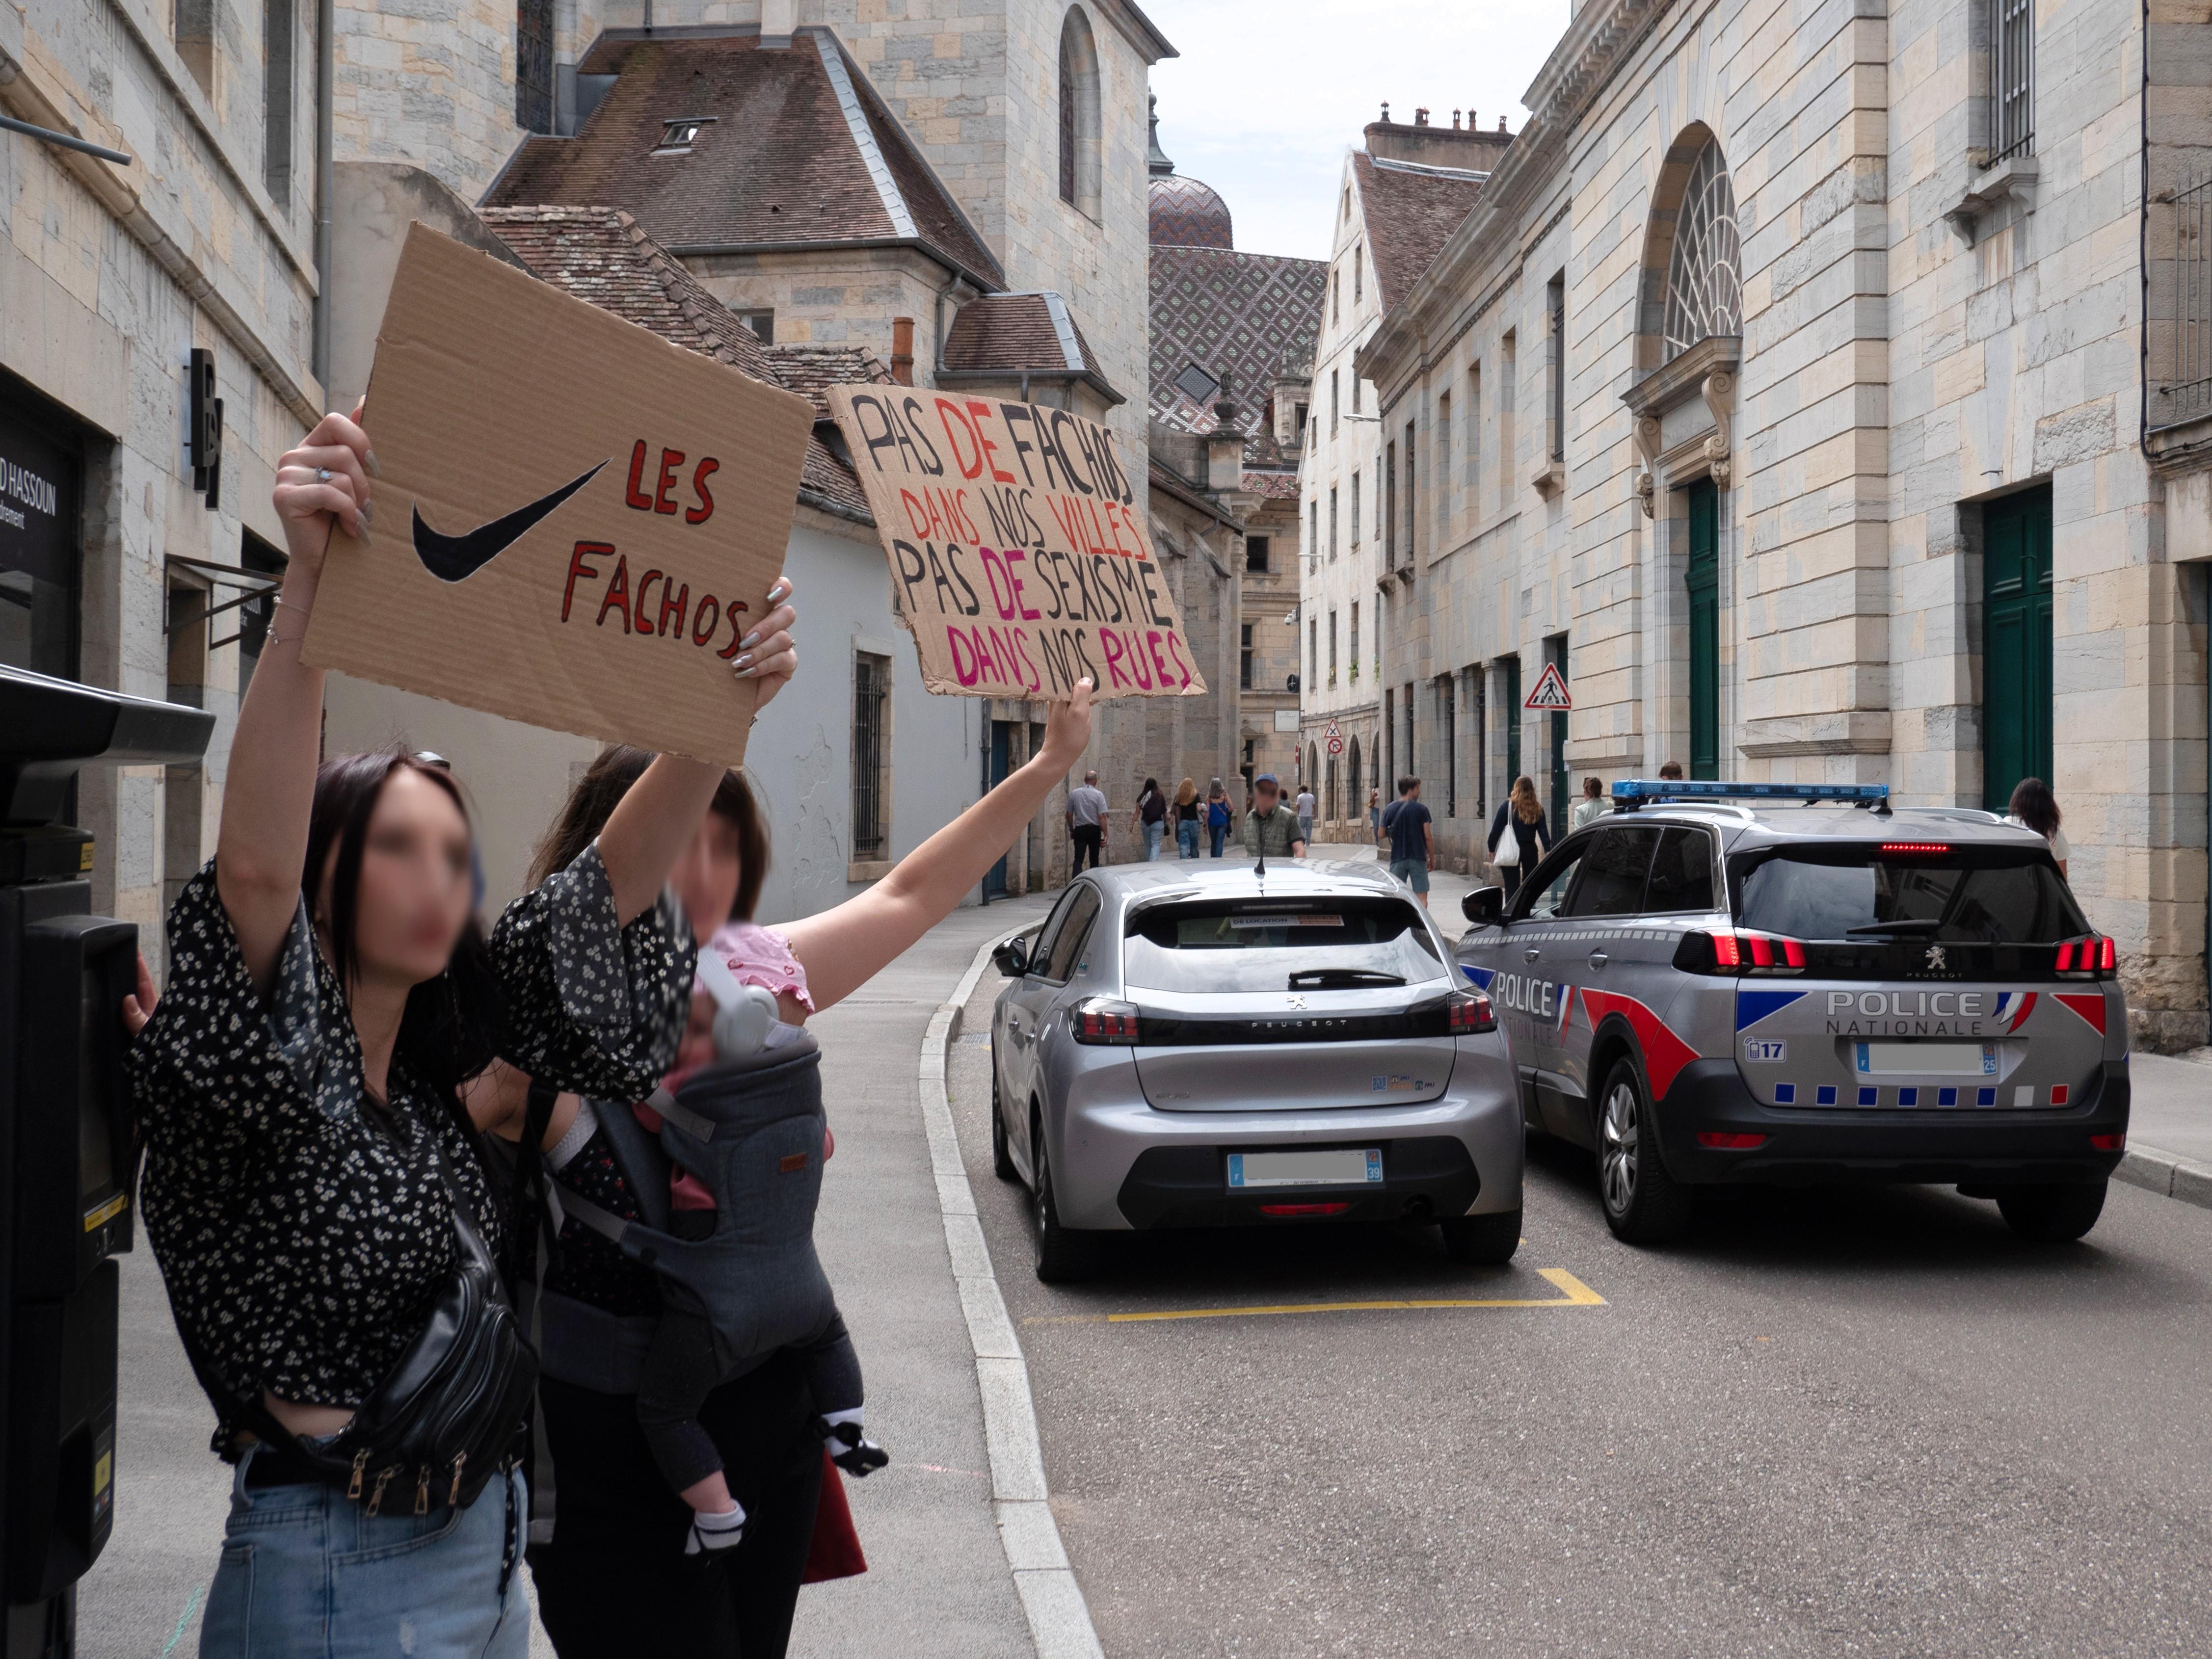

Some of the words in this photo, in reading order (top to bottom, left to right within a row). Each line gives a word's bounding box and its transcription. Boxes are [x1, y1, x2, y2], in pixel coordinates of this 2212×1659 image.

[851, 395, 944, 476] PAS
[934, 398, 1017, 484] DE
[999, 403, 1133, 505] FACHOS
[9, 462, 55, 516] HASSOUN
[626, 439, 720, 525] LES
[900, 485, 981, 545] DANS
[980, 484, 1045, 548] NOS
[1045, 494, 1146, 560] VILLES
[561, 540, 748, 659] FACHOS
[892, 539, 981, 616] PAS
[979, 547, 1041, 621] DE
[1035, 549, 1173, 628] SEXISME
[947, 625, 1040, 692] DANS
[1039, 628, 1099, 694] NOS
[1099, 627, 1191, 690] RUES
[1496, 971, 1553, 1017] POLICE
[1826, 990, 1983, 1017] POLICE
[1252, 1019, 1347, 1028] PEUGEOT
[1504, 1015, 1552, 1047] TIONALE
[1826, 1020, 1983, 1035] NATIONALE
[1761, 1043, 1783, 1058] 17
[1984, 1059, 1996, 1071] 25
[1233, 1173, 1240, 1182] F
[1367, 1166, 1380, 1179] 39
